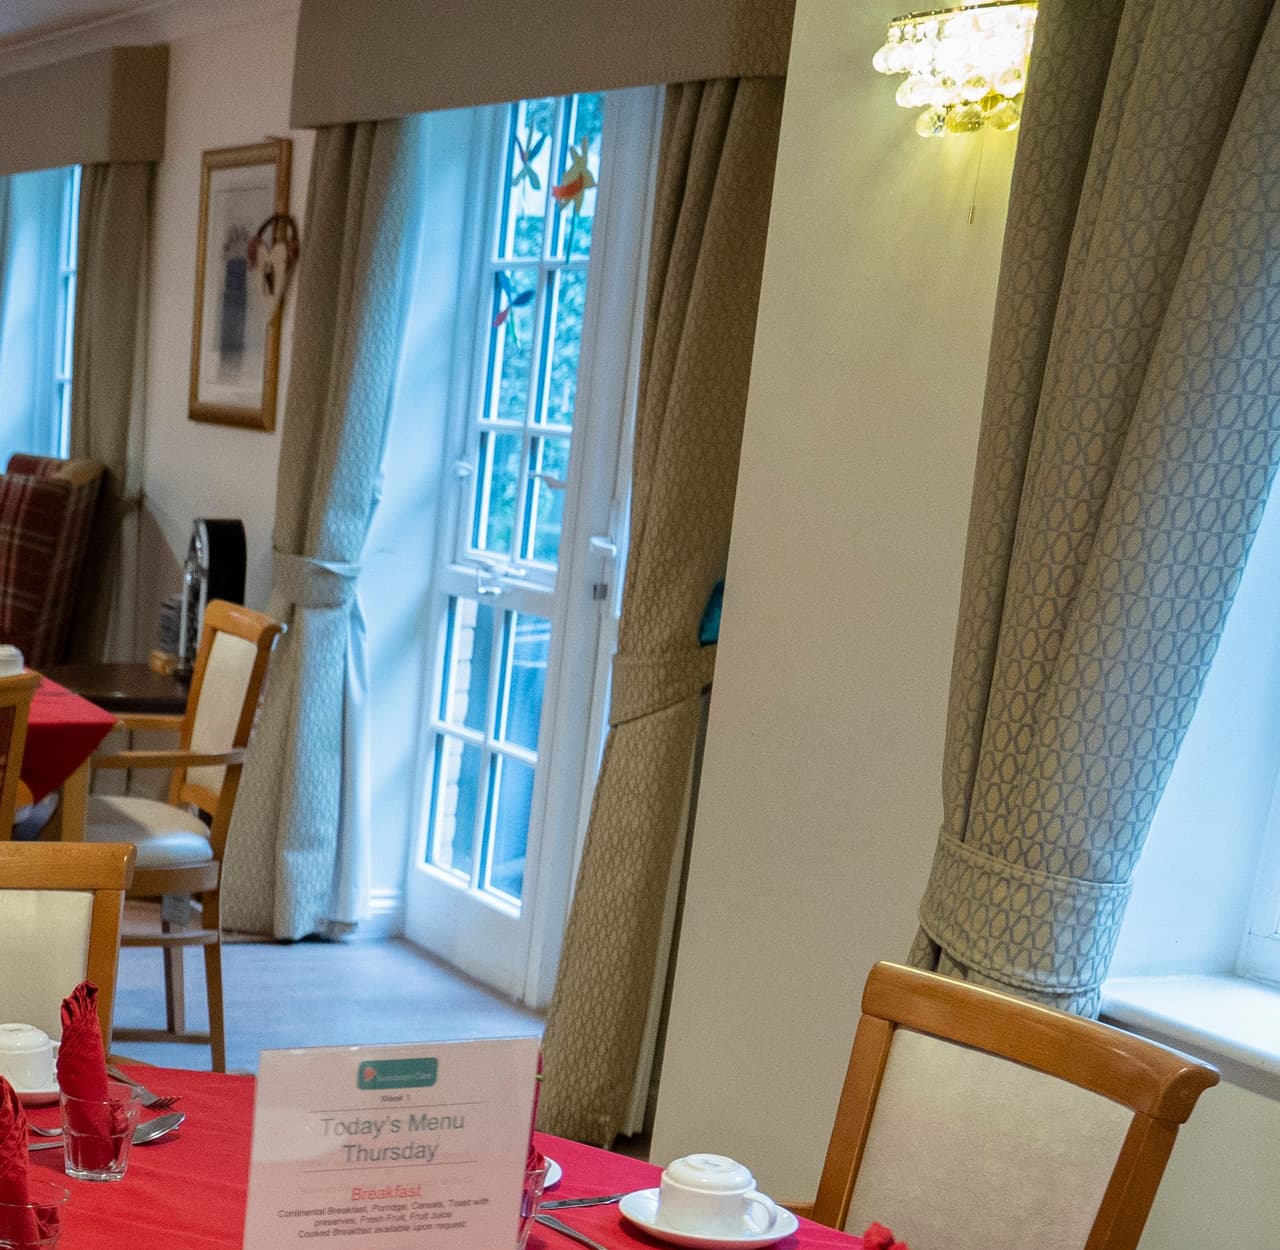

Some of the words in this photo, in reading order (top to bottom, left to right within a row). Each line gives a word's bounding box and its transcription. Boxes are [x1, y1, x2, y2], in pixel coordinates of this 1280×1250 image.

[319, 1115, 401, 1139] Today's
[407, 1113, 465, 1132] Menu
[343, 1142, 439, 1163] Thursday
[351, 1184, 422, 1201] Breakfast
